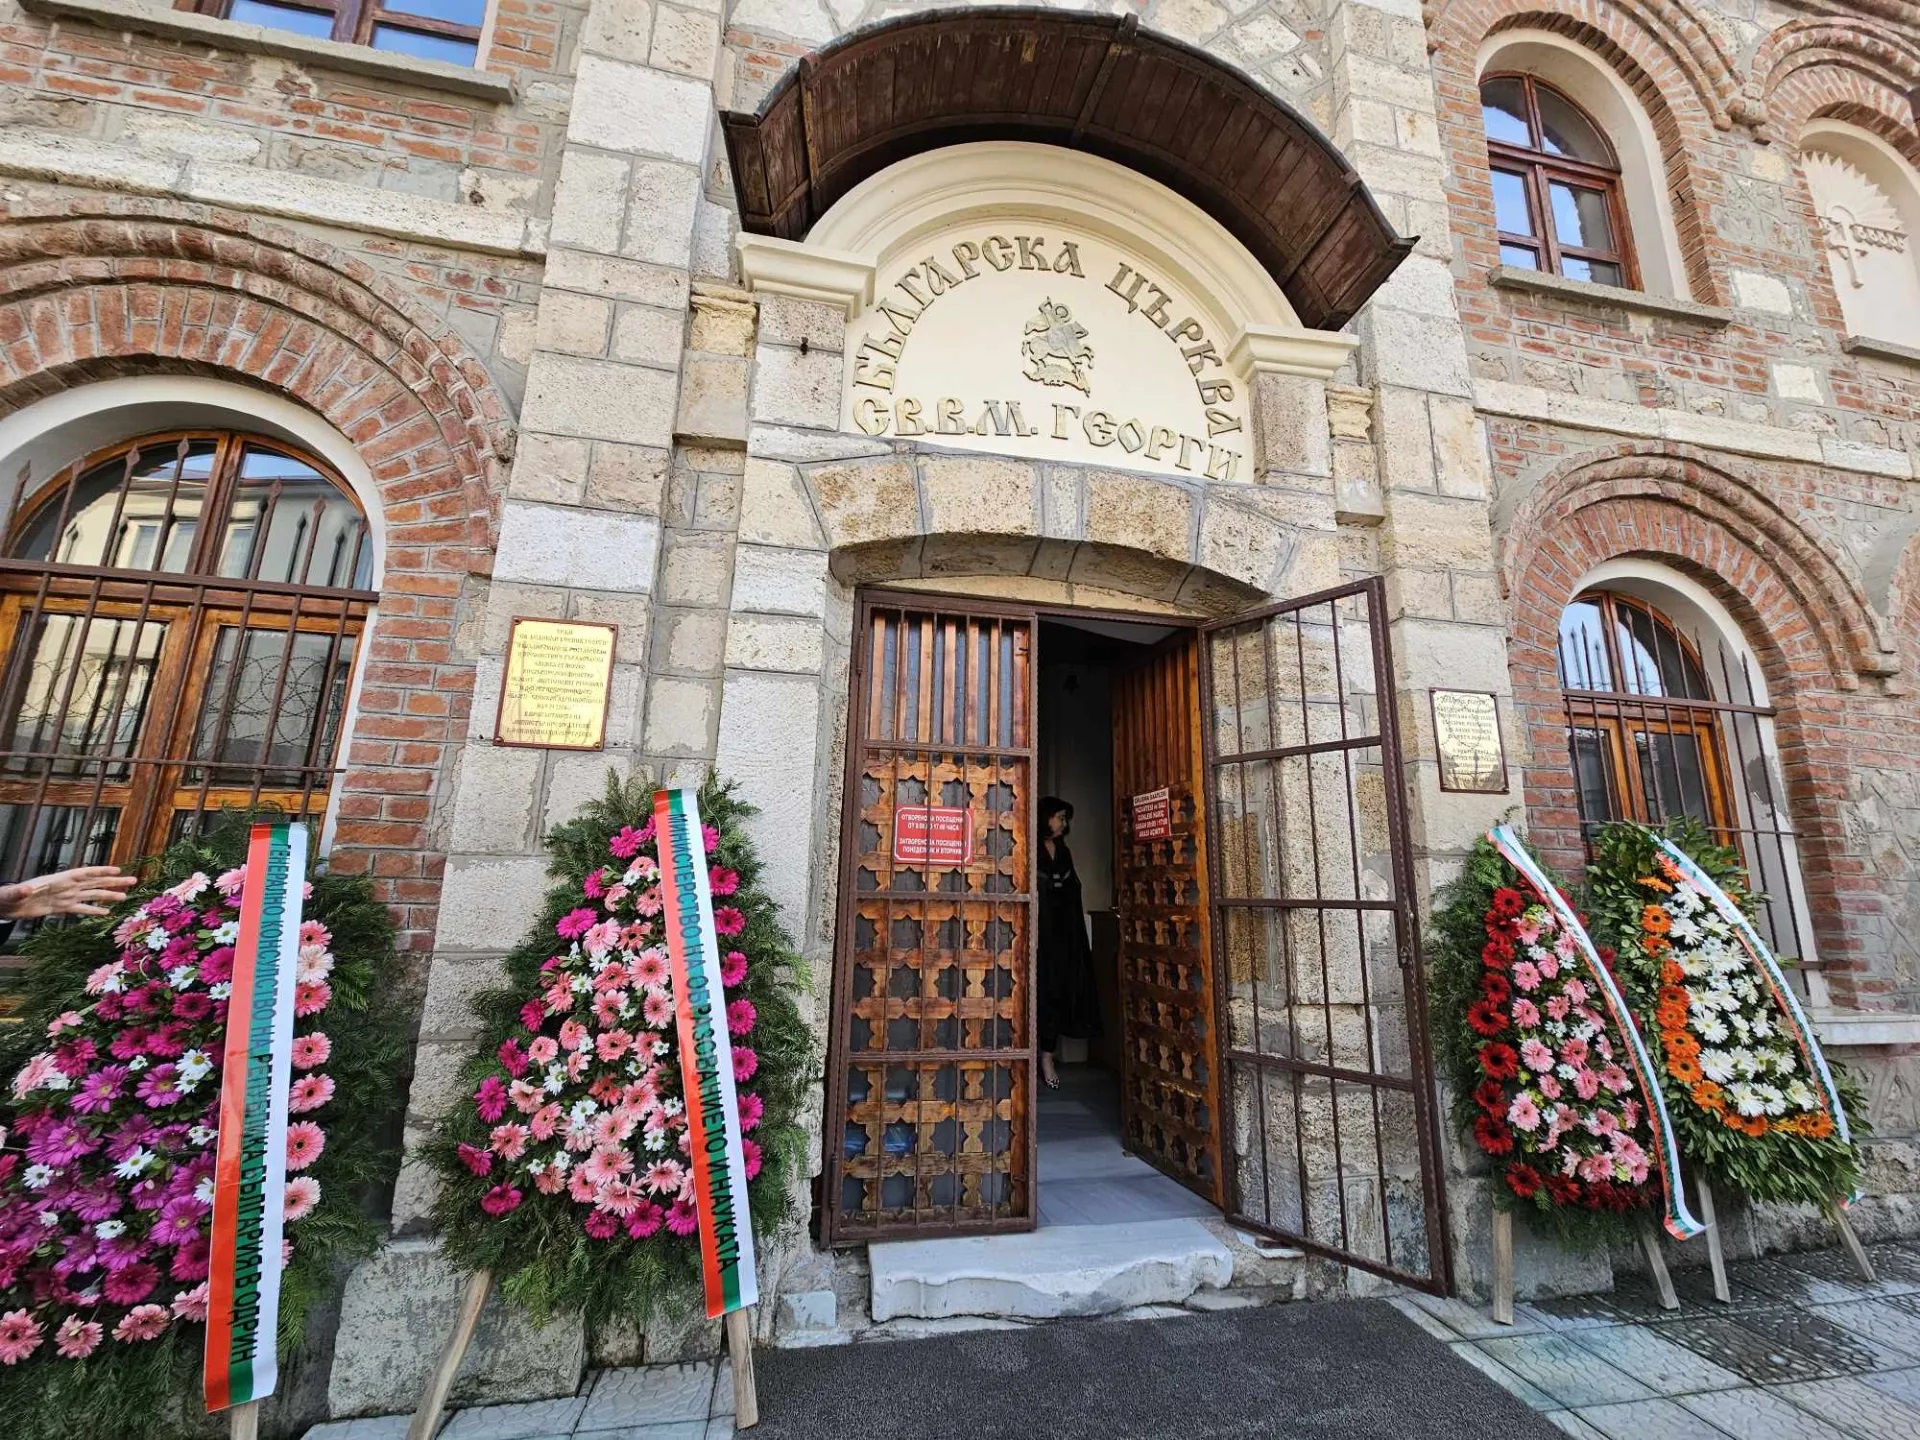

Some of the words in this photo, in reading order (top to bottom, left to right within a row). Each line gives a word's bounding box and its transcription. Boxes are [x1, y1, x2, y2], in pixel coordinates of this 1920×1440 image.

[852, 235, 1086, 394] БЪЛГАРСКА
[1104, 262, 1243, 439] ЦЪРКВА
[1051, 403, 1243, 481] ГЕОРГИ
[935, 815, 964, 823] ПОСЕЩЕНИ
[263, 842, 292, 916] ГЕНЕРАЛНО
[667, 813, 703, 939] МИНИСТЕРСТВО
[252, 920, 284, 1021] КОНСУЛСТВО
[683, 943, 706, 973] НА
[250, 1025, 275, 1049] НА
[686, 976, 729, 1154] ОБРАЗОВАНИЕТО
[241, 1053, 274, 1162] РЕПУБЛИКА
[707, 1157, 730, 1175] И
[235, 1165, 268, 1272] БЪЛГАРИЯ
[708, 1176, 740, 1274] НАУКАТА
[235, 1272, 262, 1288] В
[227, 1291, 261, 1365] ОДРИН
